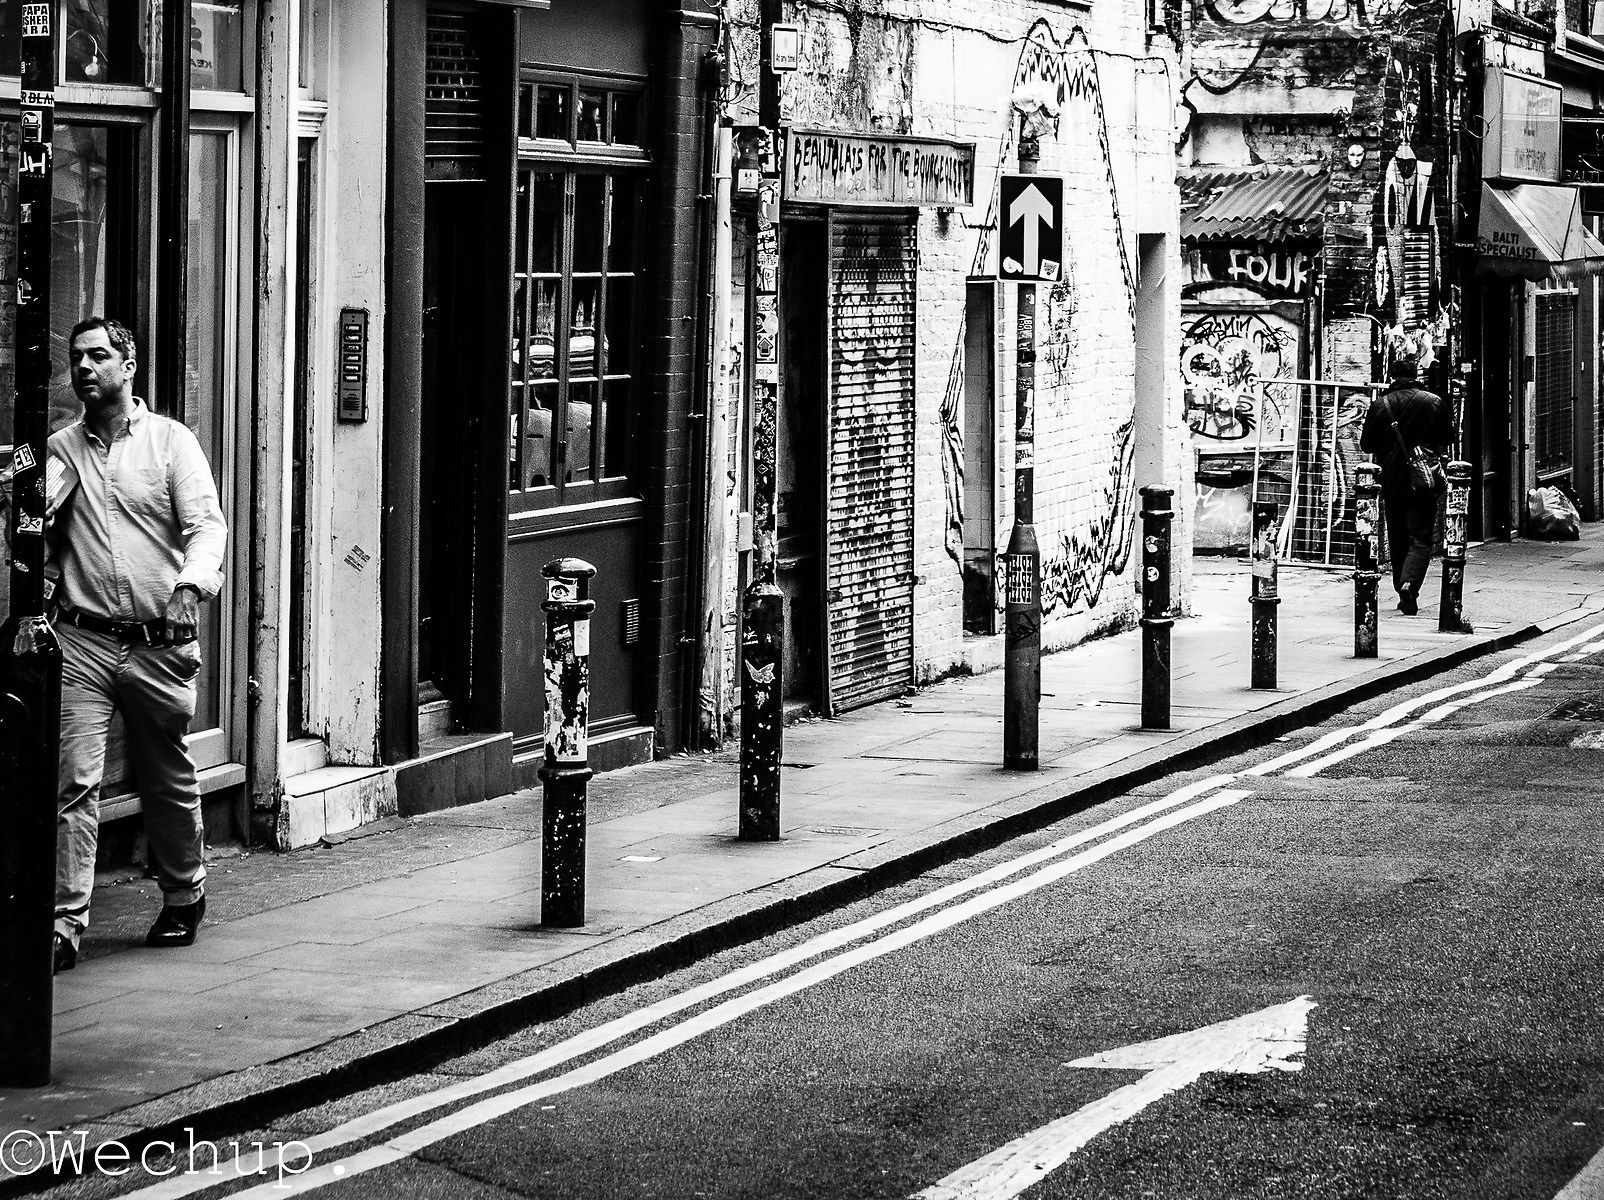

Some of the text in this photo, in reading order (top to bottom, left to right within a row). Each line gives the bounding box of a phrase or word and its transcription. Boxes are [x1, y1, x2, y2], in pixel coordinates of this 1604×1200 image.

[22, 15, 48, 26] SHER
[868, 143, 888, 173] FOR
[1492, 231, 1519, 244] BALTI
[1480, 242, 1537, 258] SPECIALIST
